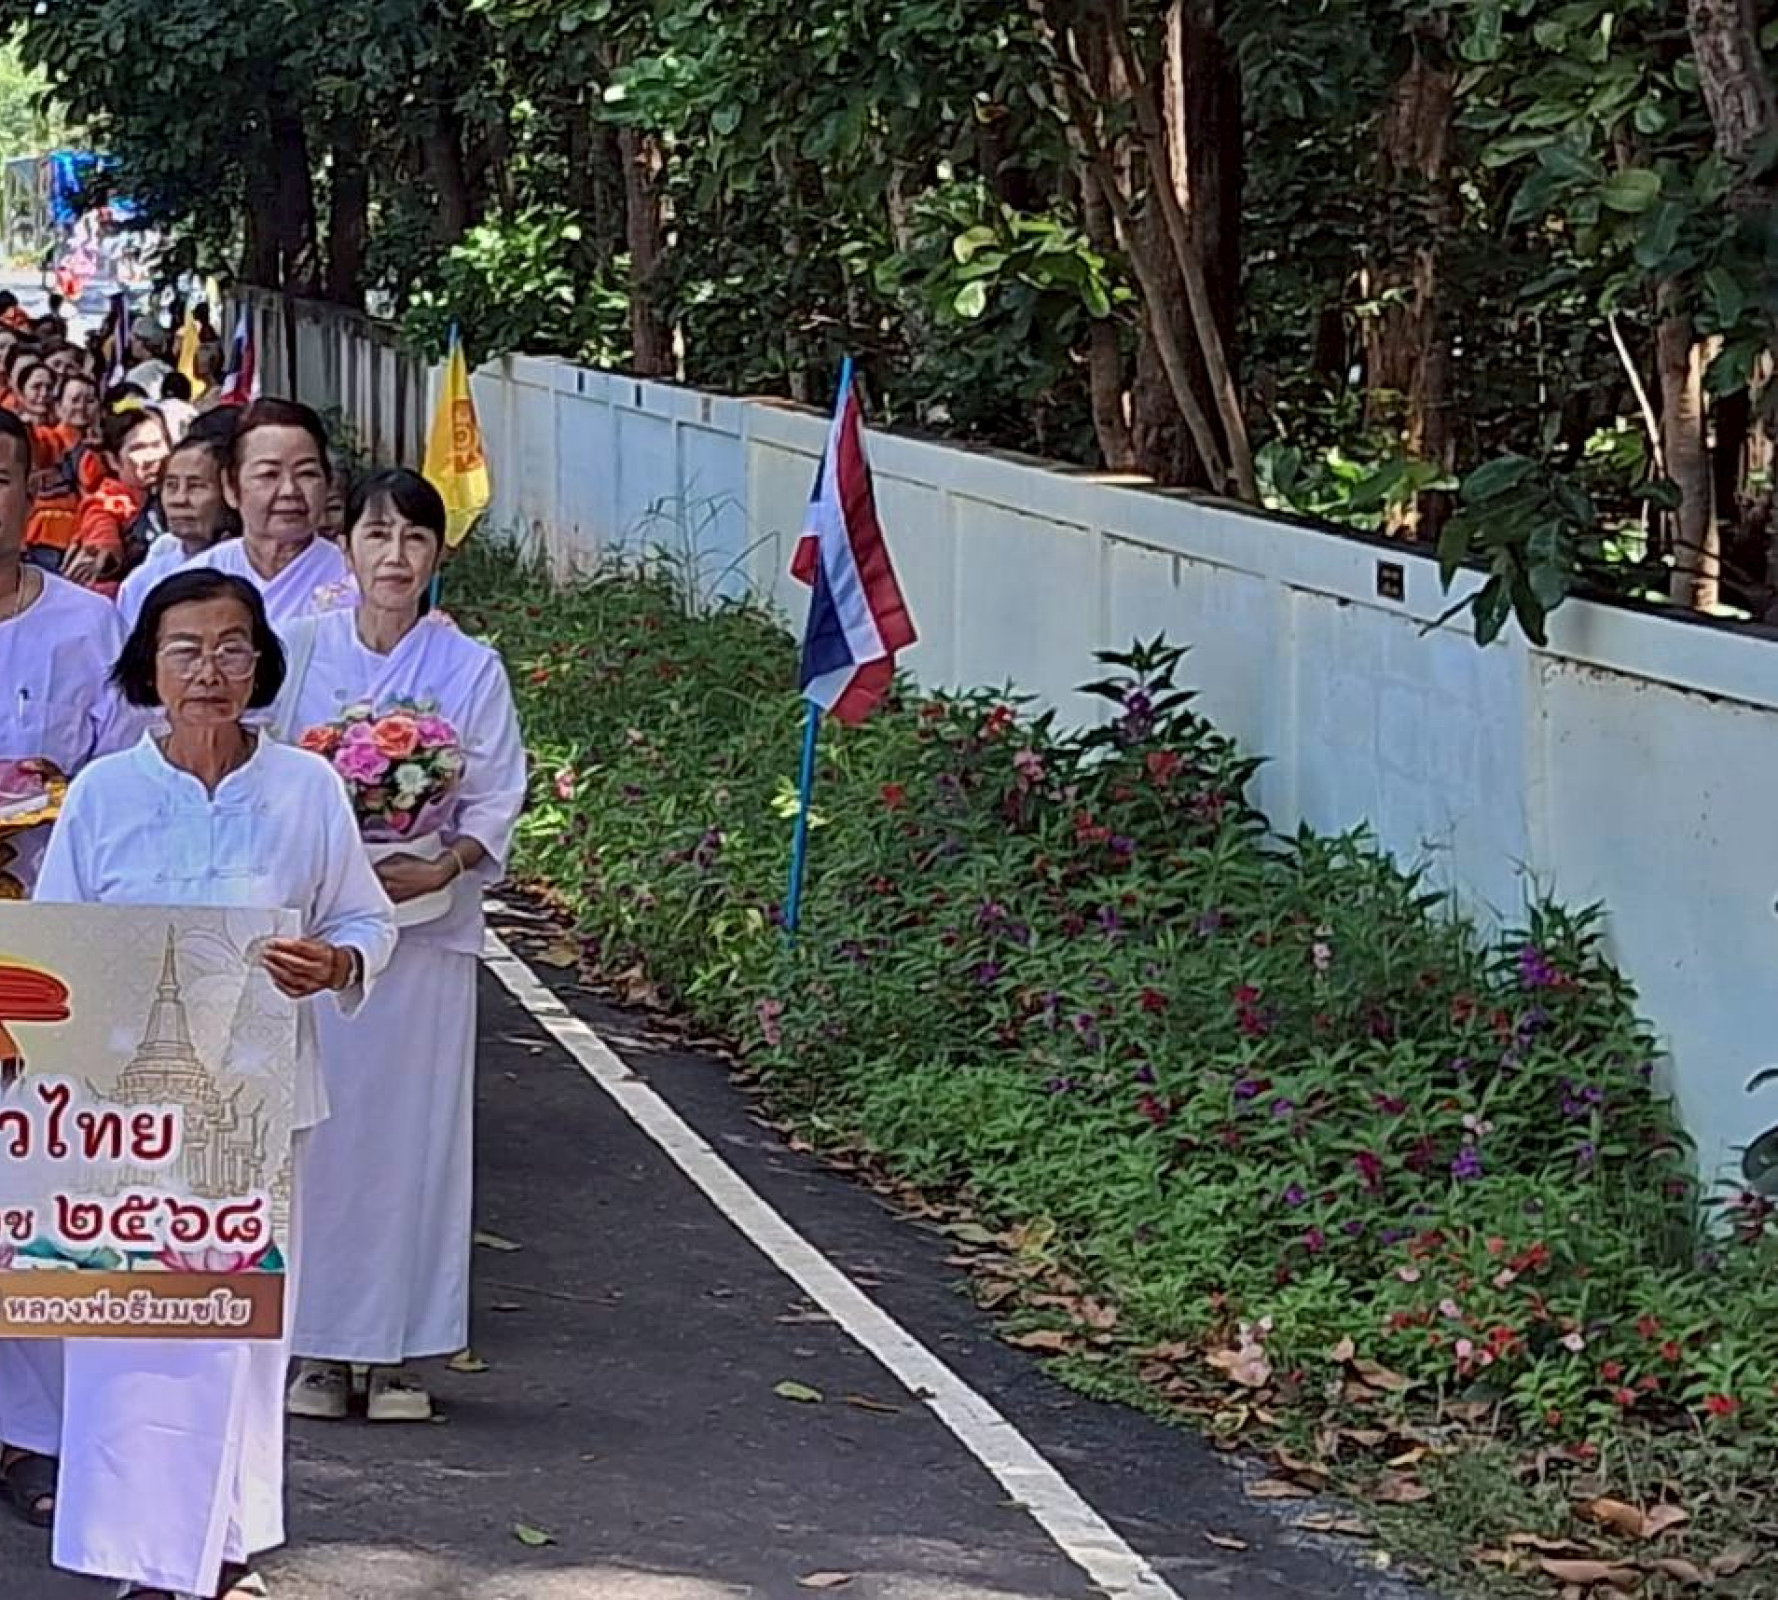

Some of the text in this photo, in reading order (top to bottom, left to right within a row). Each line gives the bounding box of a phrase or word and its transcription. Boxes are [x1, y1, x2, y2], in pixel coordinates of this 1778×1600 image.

[54, 1194, 264, 1244] ๒๕๖๘
[5, 1287, 252, 1325] หลวงพ่อธัมมชโย
